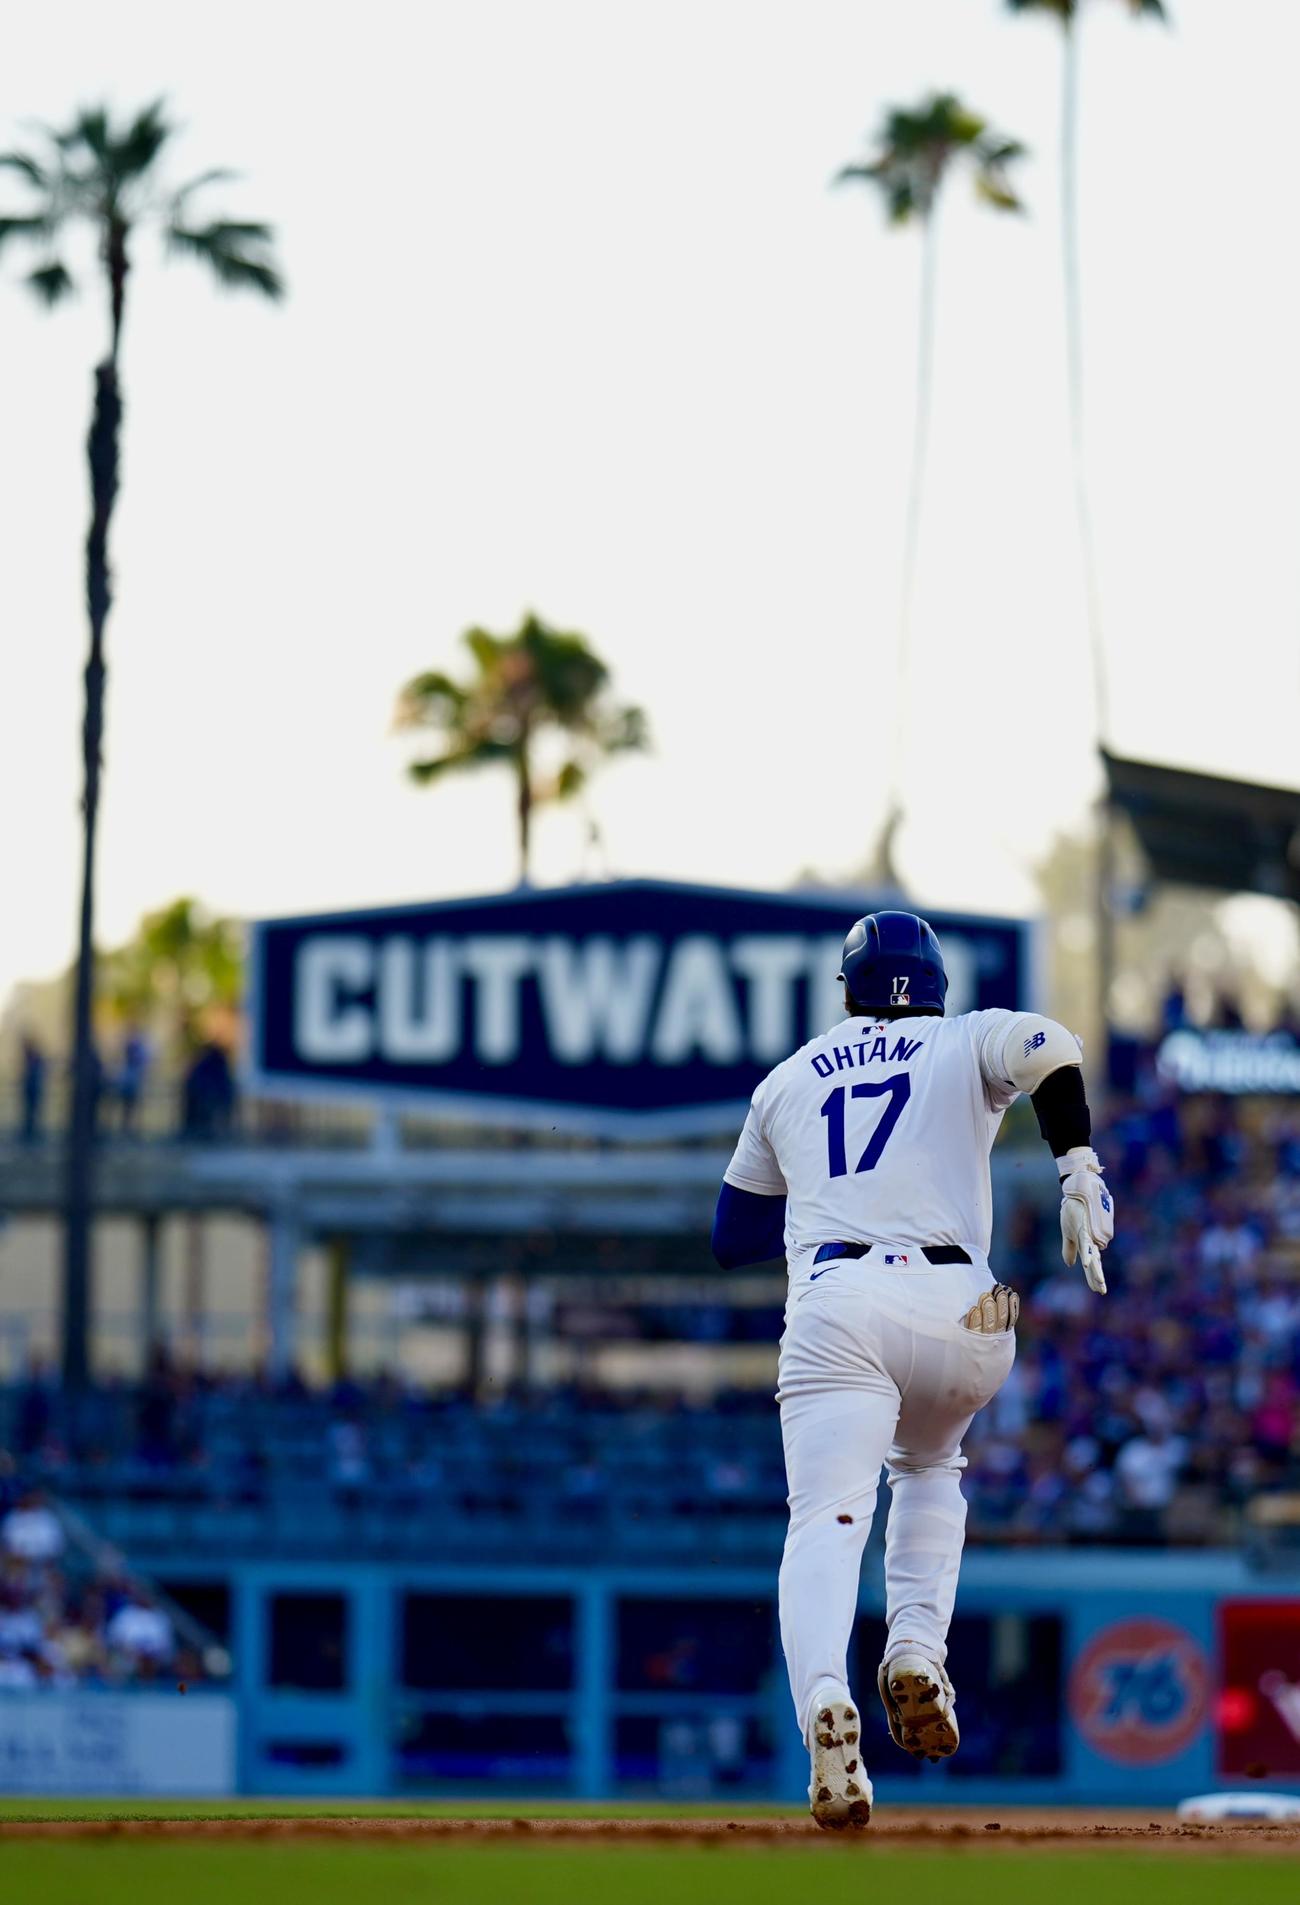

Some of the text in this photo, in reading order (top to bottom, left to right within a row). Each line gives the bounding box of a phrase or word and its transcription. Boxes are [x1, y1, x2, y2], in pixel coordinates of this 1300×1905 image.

[892, 976, 909, 994] 17
[811, 1036, 924, 1078] OHTANI
[821, 1072, 911, 1179] 17
